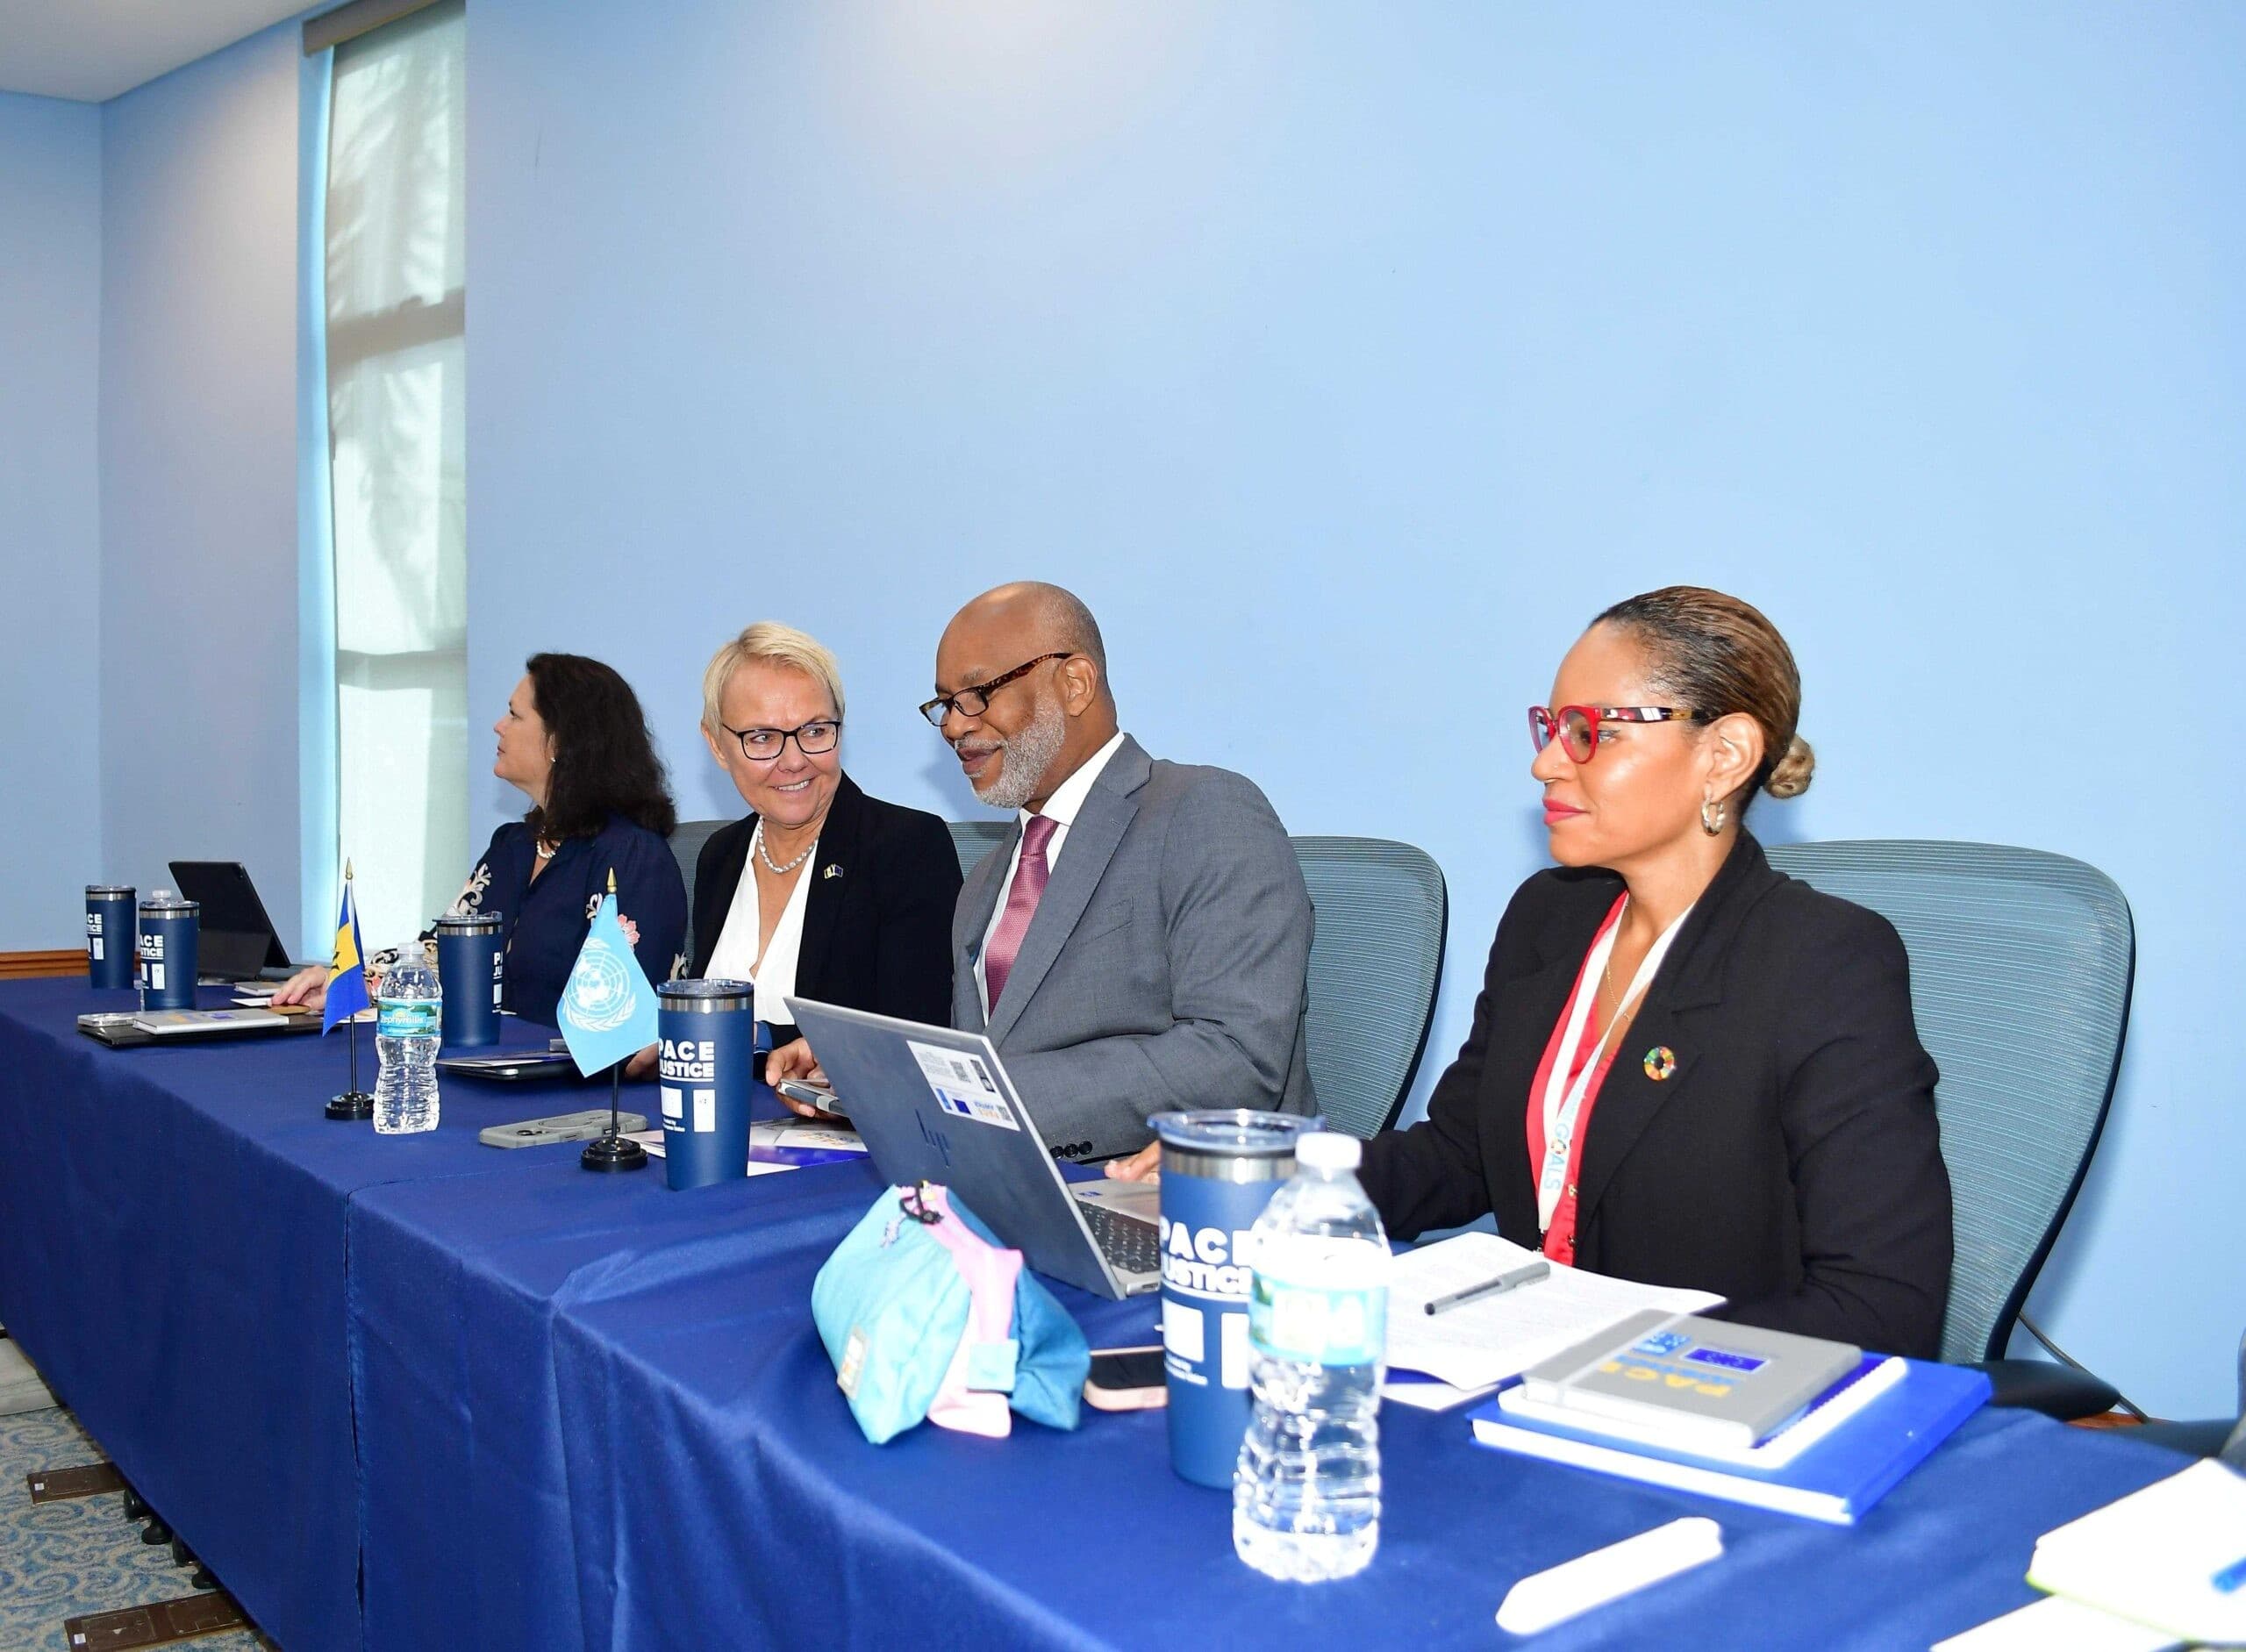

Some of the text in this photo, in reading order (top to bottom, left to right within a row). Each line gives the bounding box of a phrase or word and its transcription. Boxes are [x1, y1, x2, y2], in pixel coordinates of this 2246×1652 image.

[87, 913, 103, 925] CE
[660, 1058, 715, 1078] USTICE
[1161, 1252, 1253, 1295] USTIC
